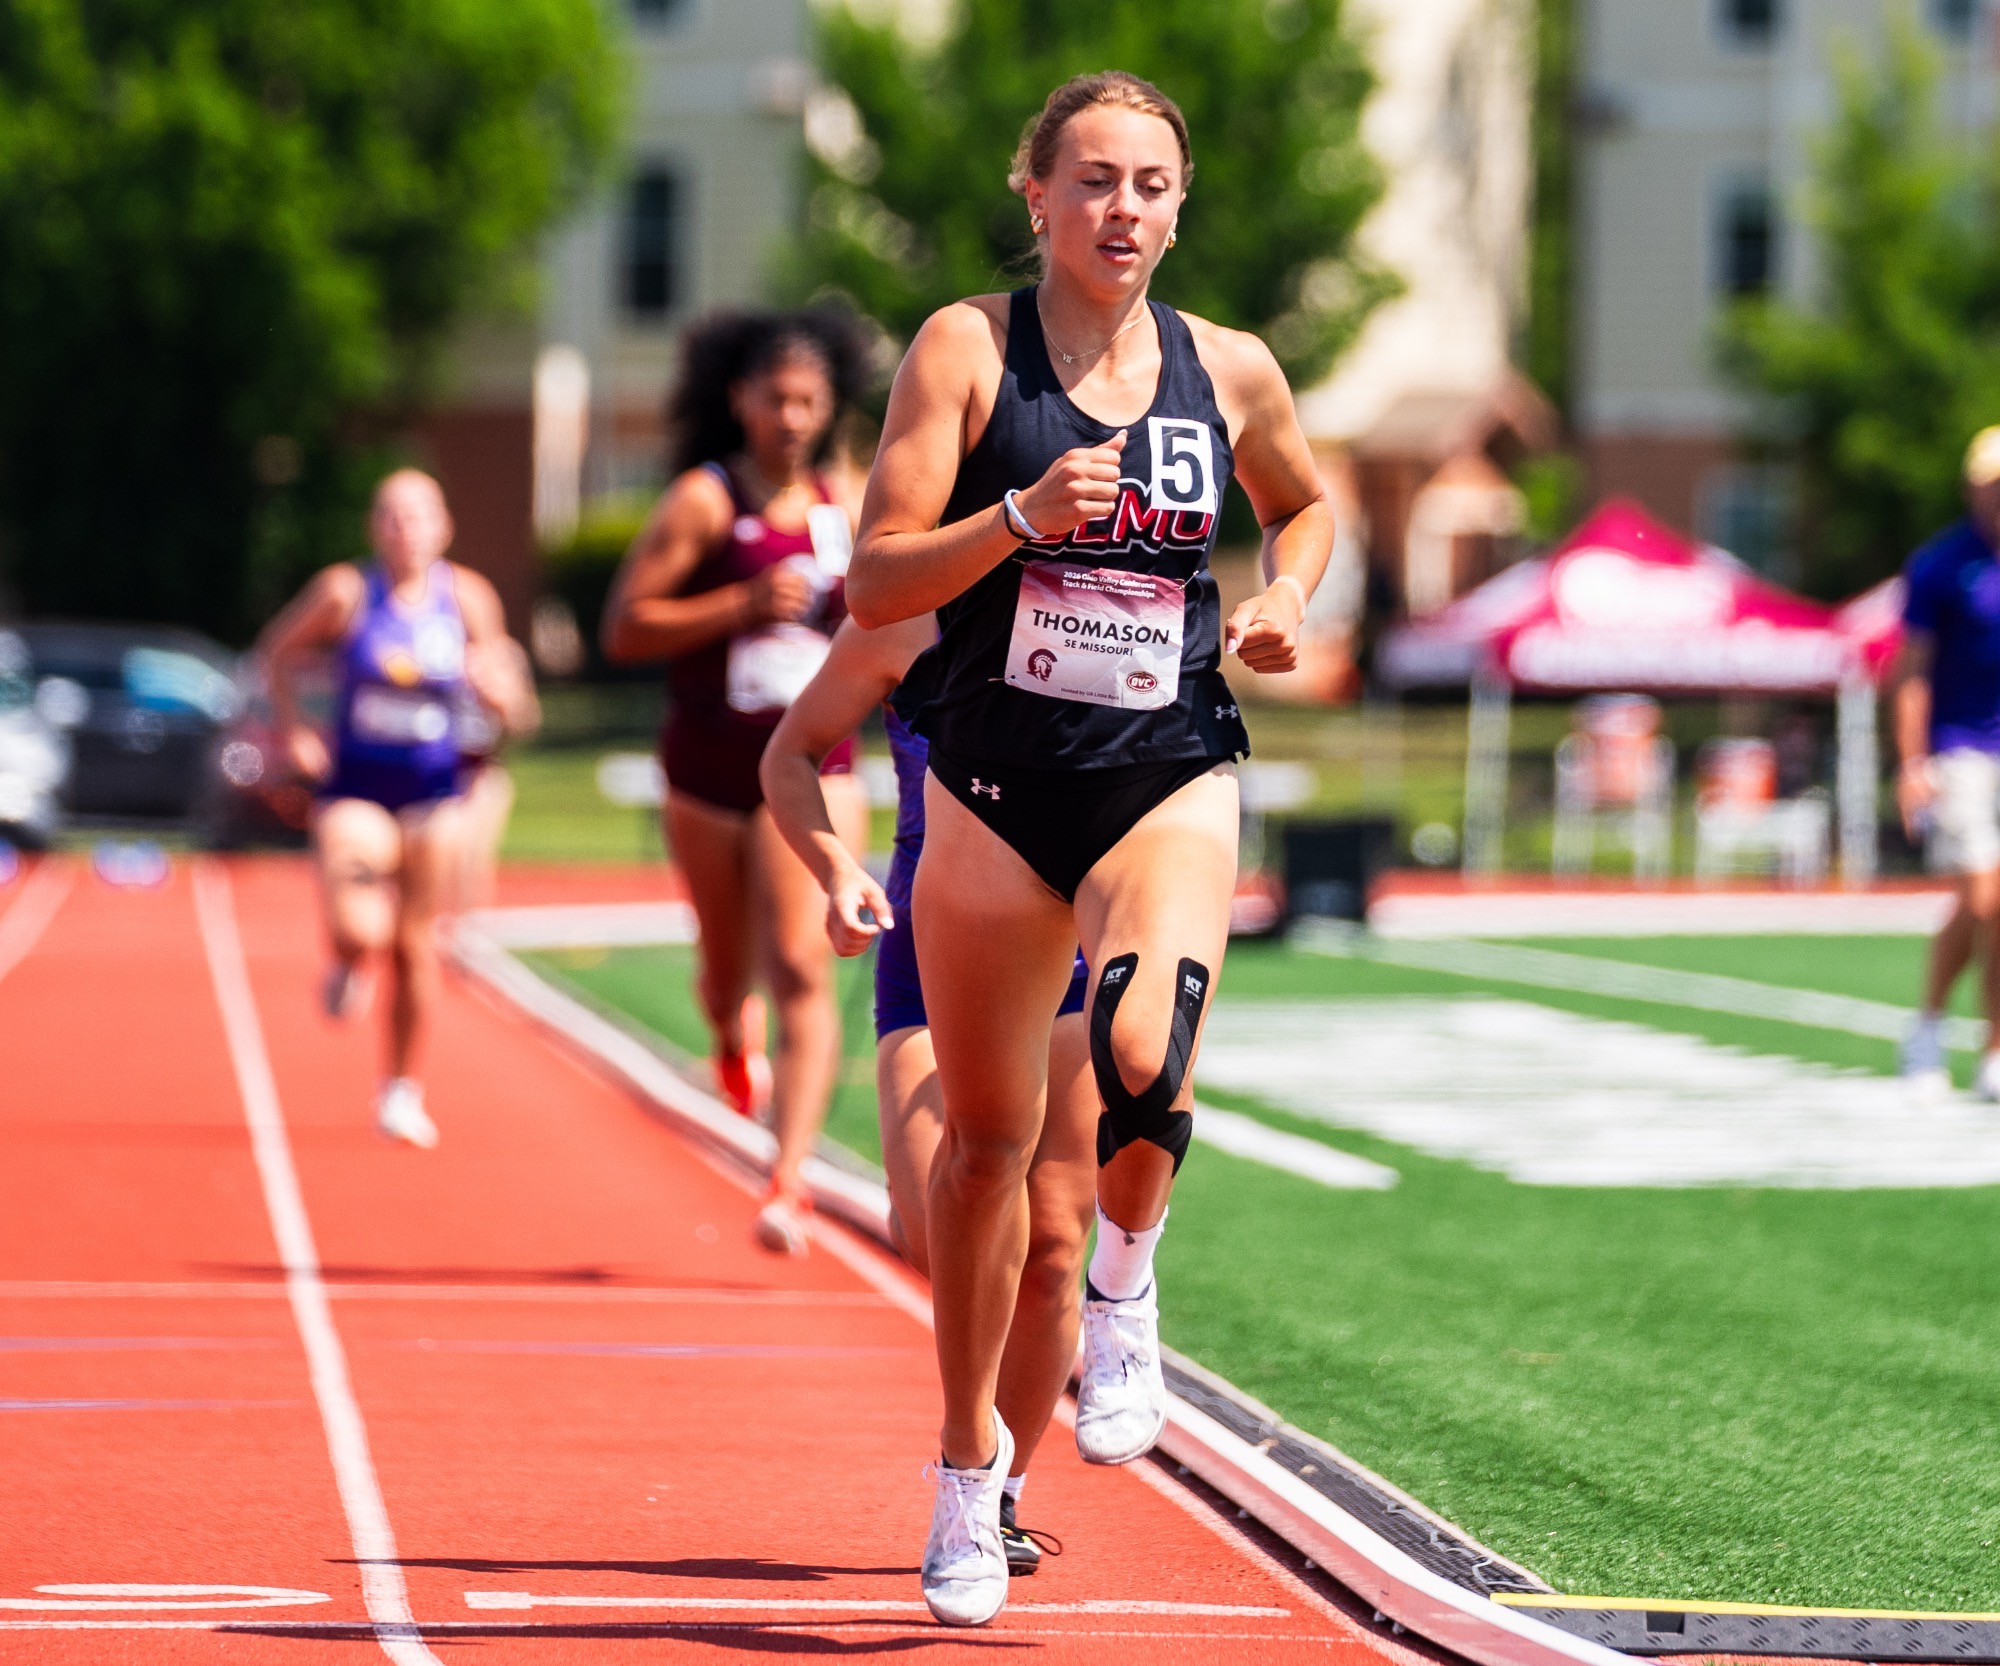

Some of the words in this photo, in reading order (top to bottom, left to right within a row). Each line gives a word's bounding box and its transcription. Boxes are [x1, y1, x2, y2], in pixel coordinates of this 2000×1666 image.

[1160, 425, 1204, 504] 5
[1062, 580, 1081, 588] Track
[1087, 583, 1105, 591] Field
[1105, 585, 1155, 598] Championships
[1063, 571, 1082, 580] 2026
[1082, 573, 1098, 582] Ohio
[1099, 575, 1120, 586] Valley
[1119, 579, 1156, 590] Conference
[1032, 608, 1169, 645] THOMASON
[1064, 639, 1077, 648] SE
[1079, 642, 1133, 656] MISSOURI
[1131, 677, 1151, 688] OVC
[1105, 966, 1127, 981] KT
[1185, 974, 1202, 994] KT
